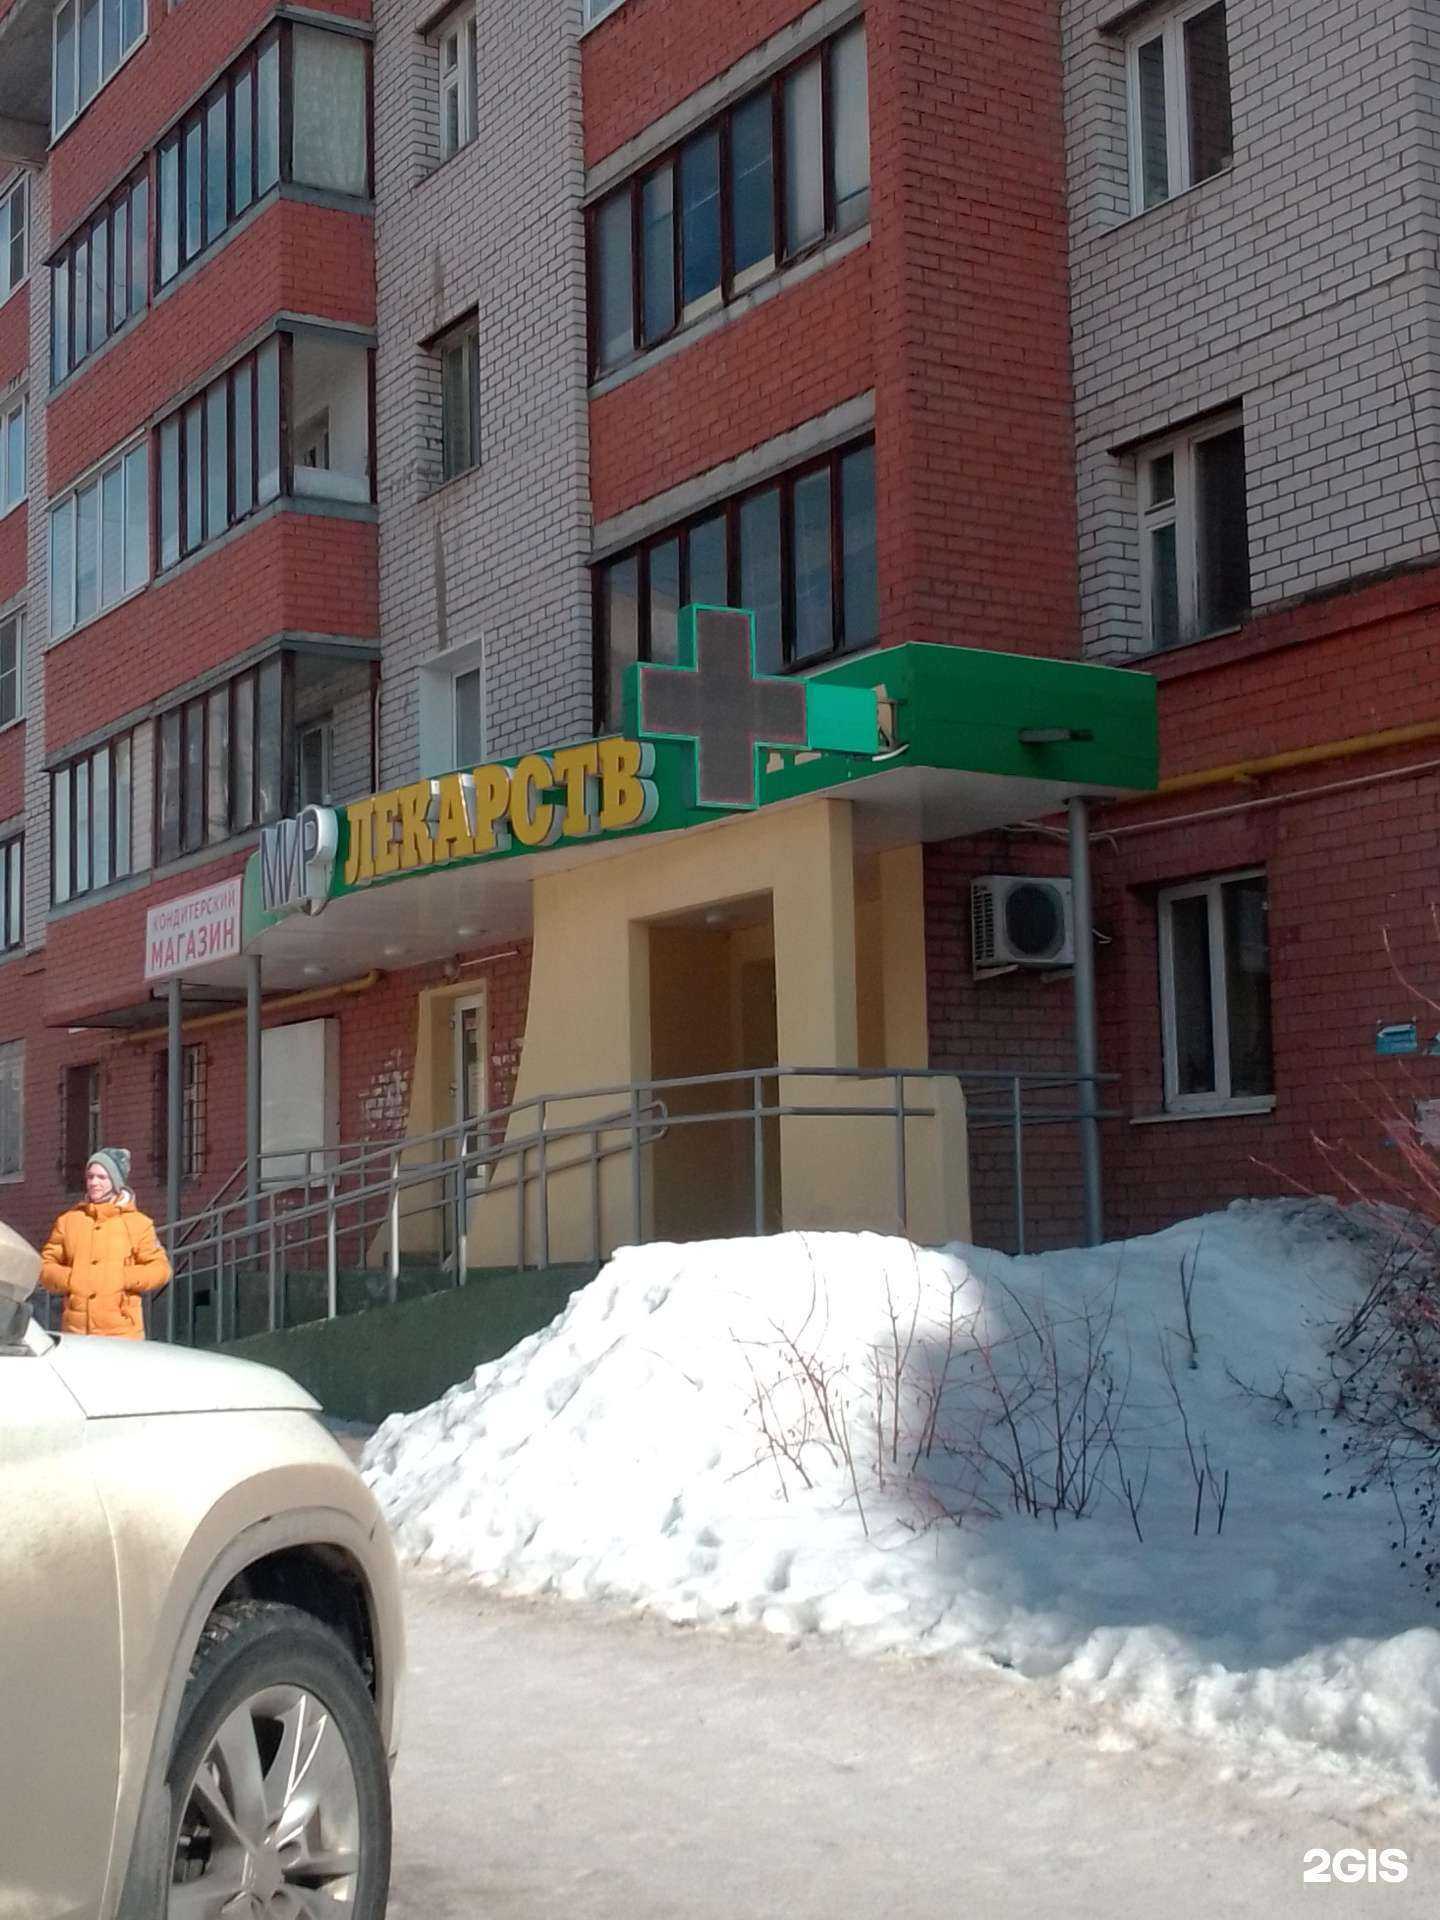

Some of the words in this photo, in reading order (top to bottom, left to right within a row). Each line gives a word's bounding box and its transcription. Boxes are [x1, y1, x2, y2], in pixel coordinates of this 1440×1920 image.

[260, 806, 336, 914] МИР
[344, 737, 657, 887] ЛЕКАРСТВ
[152, 918, 234, 969] МАГАЗИН
